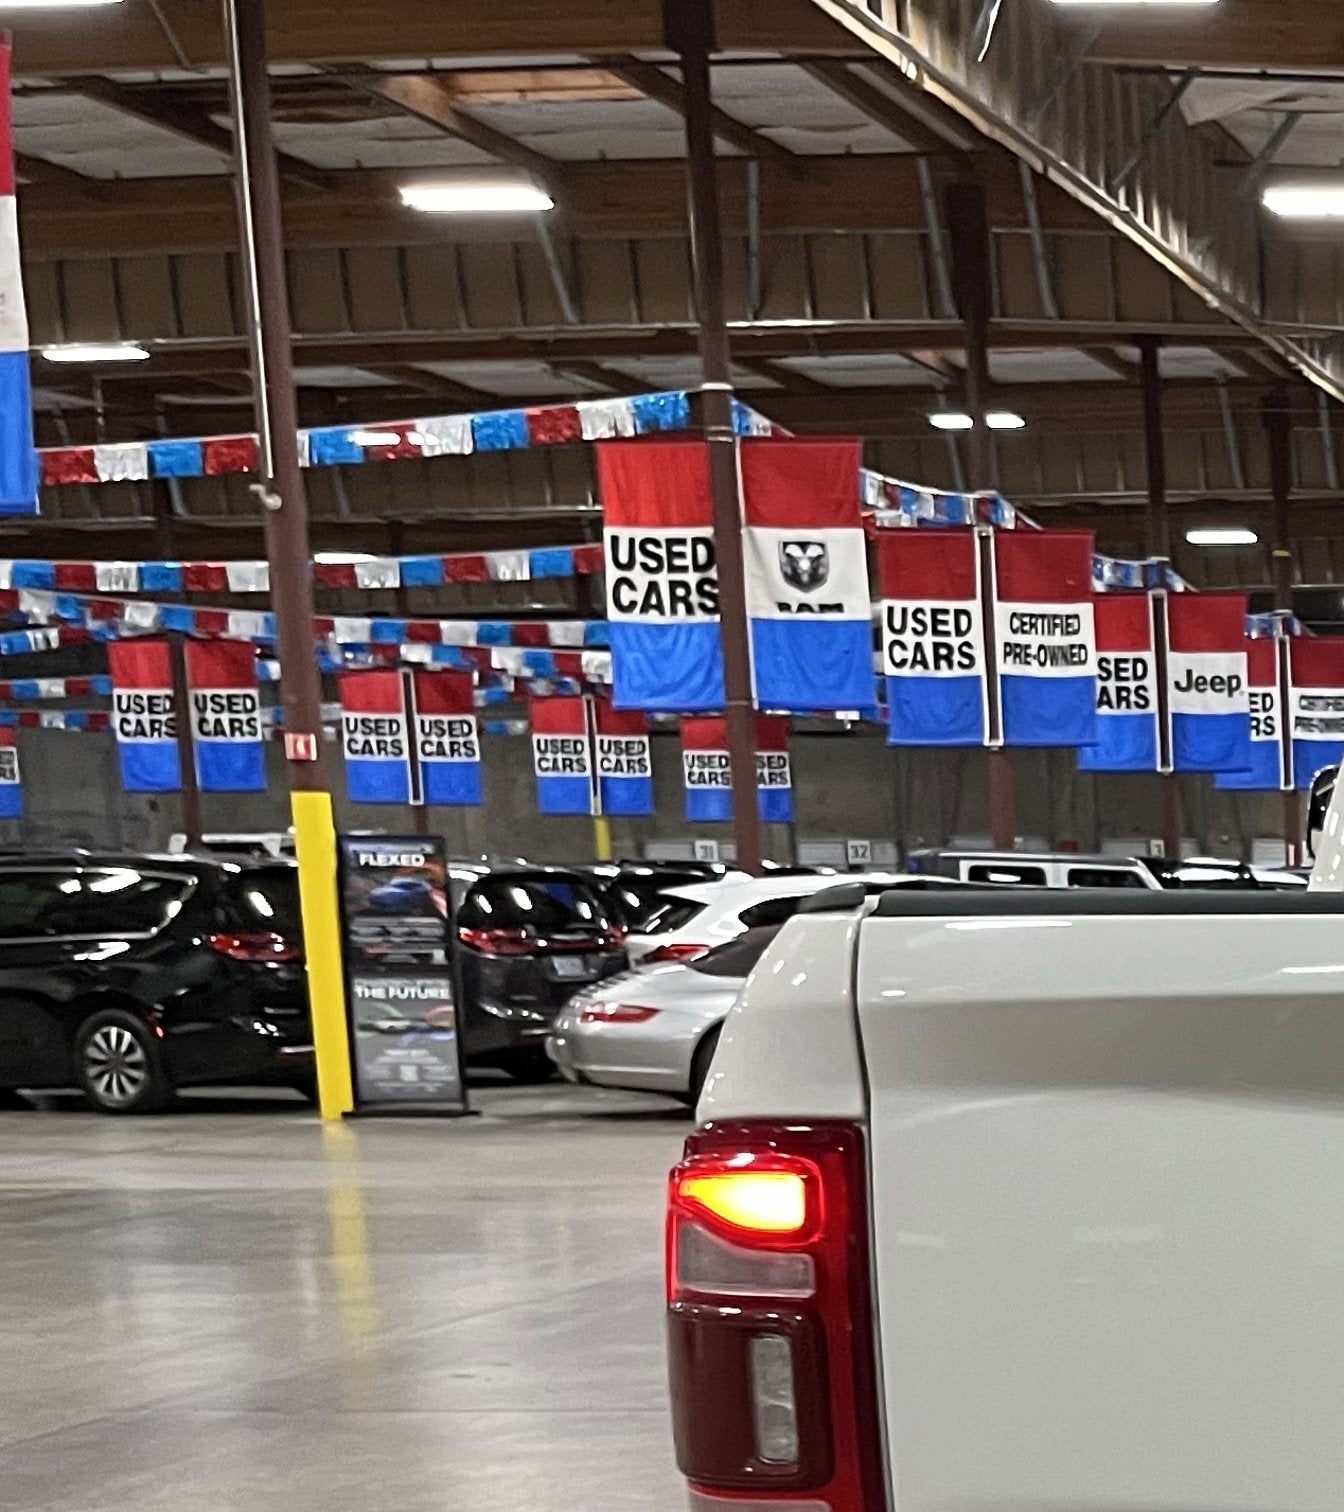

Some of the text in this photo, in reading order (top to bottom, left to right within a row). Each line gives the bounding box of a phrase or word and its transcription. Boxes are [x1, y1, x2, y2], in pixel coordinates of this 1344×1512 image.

[610, 534, 717, 574] USED
[612, 577, 719, 616] CARS
[887, 606, 973, 637] USED
[1009, 612, 1081, 636] CERTIFIED
[888, 639, 976, 670] CARS
[1003, 642, 1088, 667] PRE-OWNED
[1097, 657, 1149, 682] SED
[1174, 669, 1242, 698] Jeep
[116, 694, 174, 715] USED
[194, 693, 257, 714] USED
[1096, 685, 1150, 710] ARS
[1249, 693, 1274, 713] ED
[119, 717, 177, 738] CARS
[198, 717, 259, 738] CARS
[345, 717, 401, 736] USED
[420, 719, 473, 738] USED
[1250, 715, 1276, 736] RS
[347, 738, 404, 757] CARS
[420, 740, 476, 758] CARS
[536, 738, 585, 755] USED
[600, 738, 646, 756] USED
[537, 757, 587, 773] CARS
[600, 757, 649, 774] CARS
[685, 754, 729, 769] USED
[756, 755, 787, 770] SED
[687, 771, 732, 786] CARS
[756, 771, 788, 785] ARS
